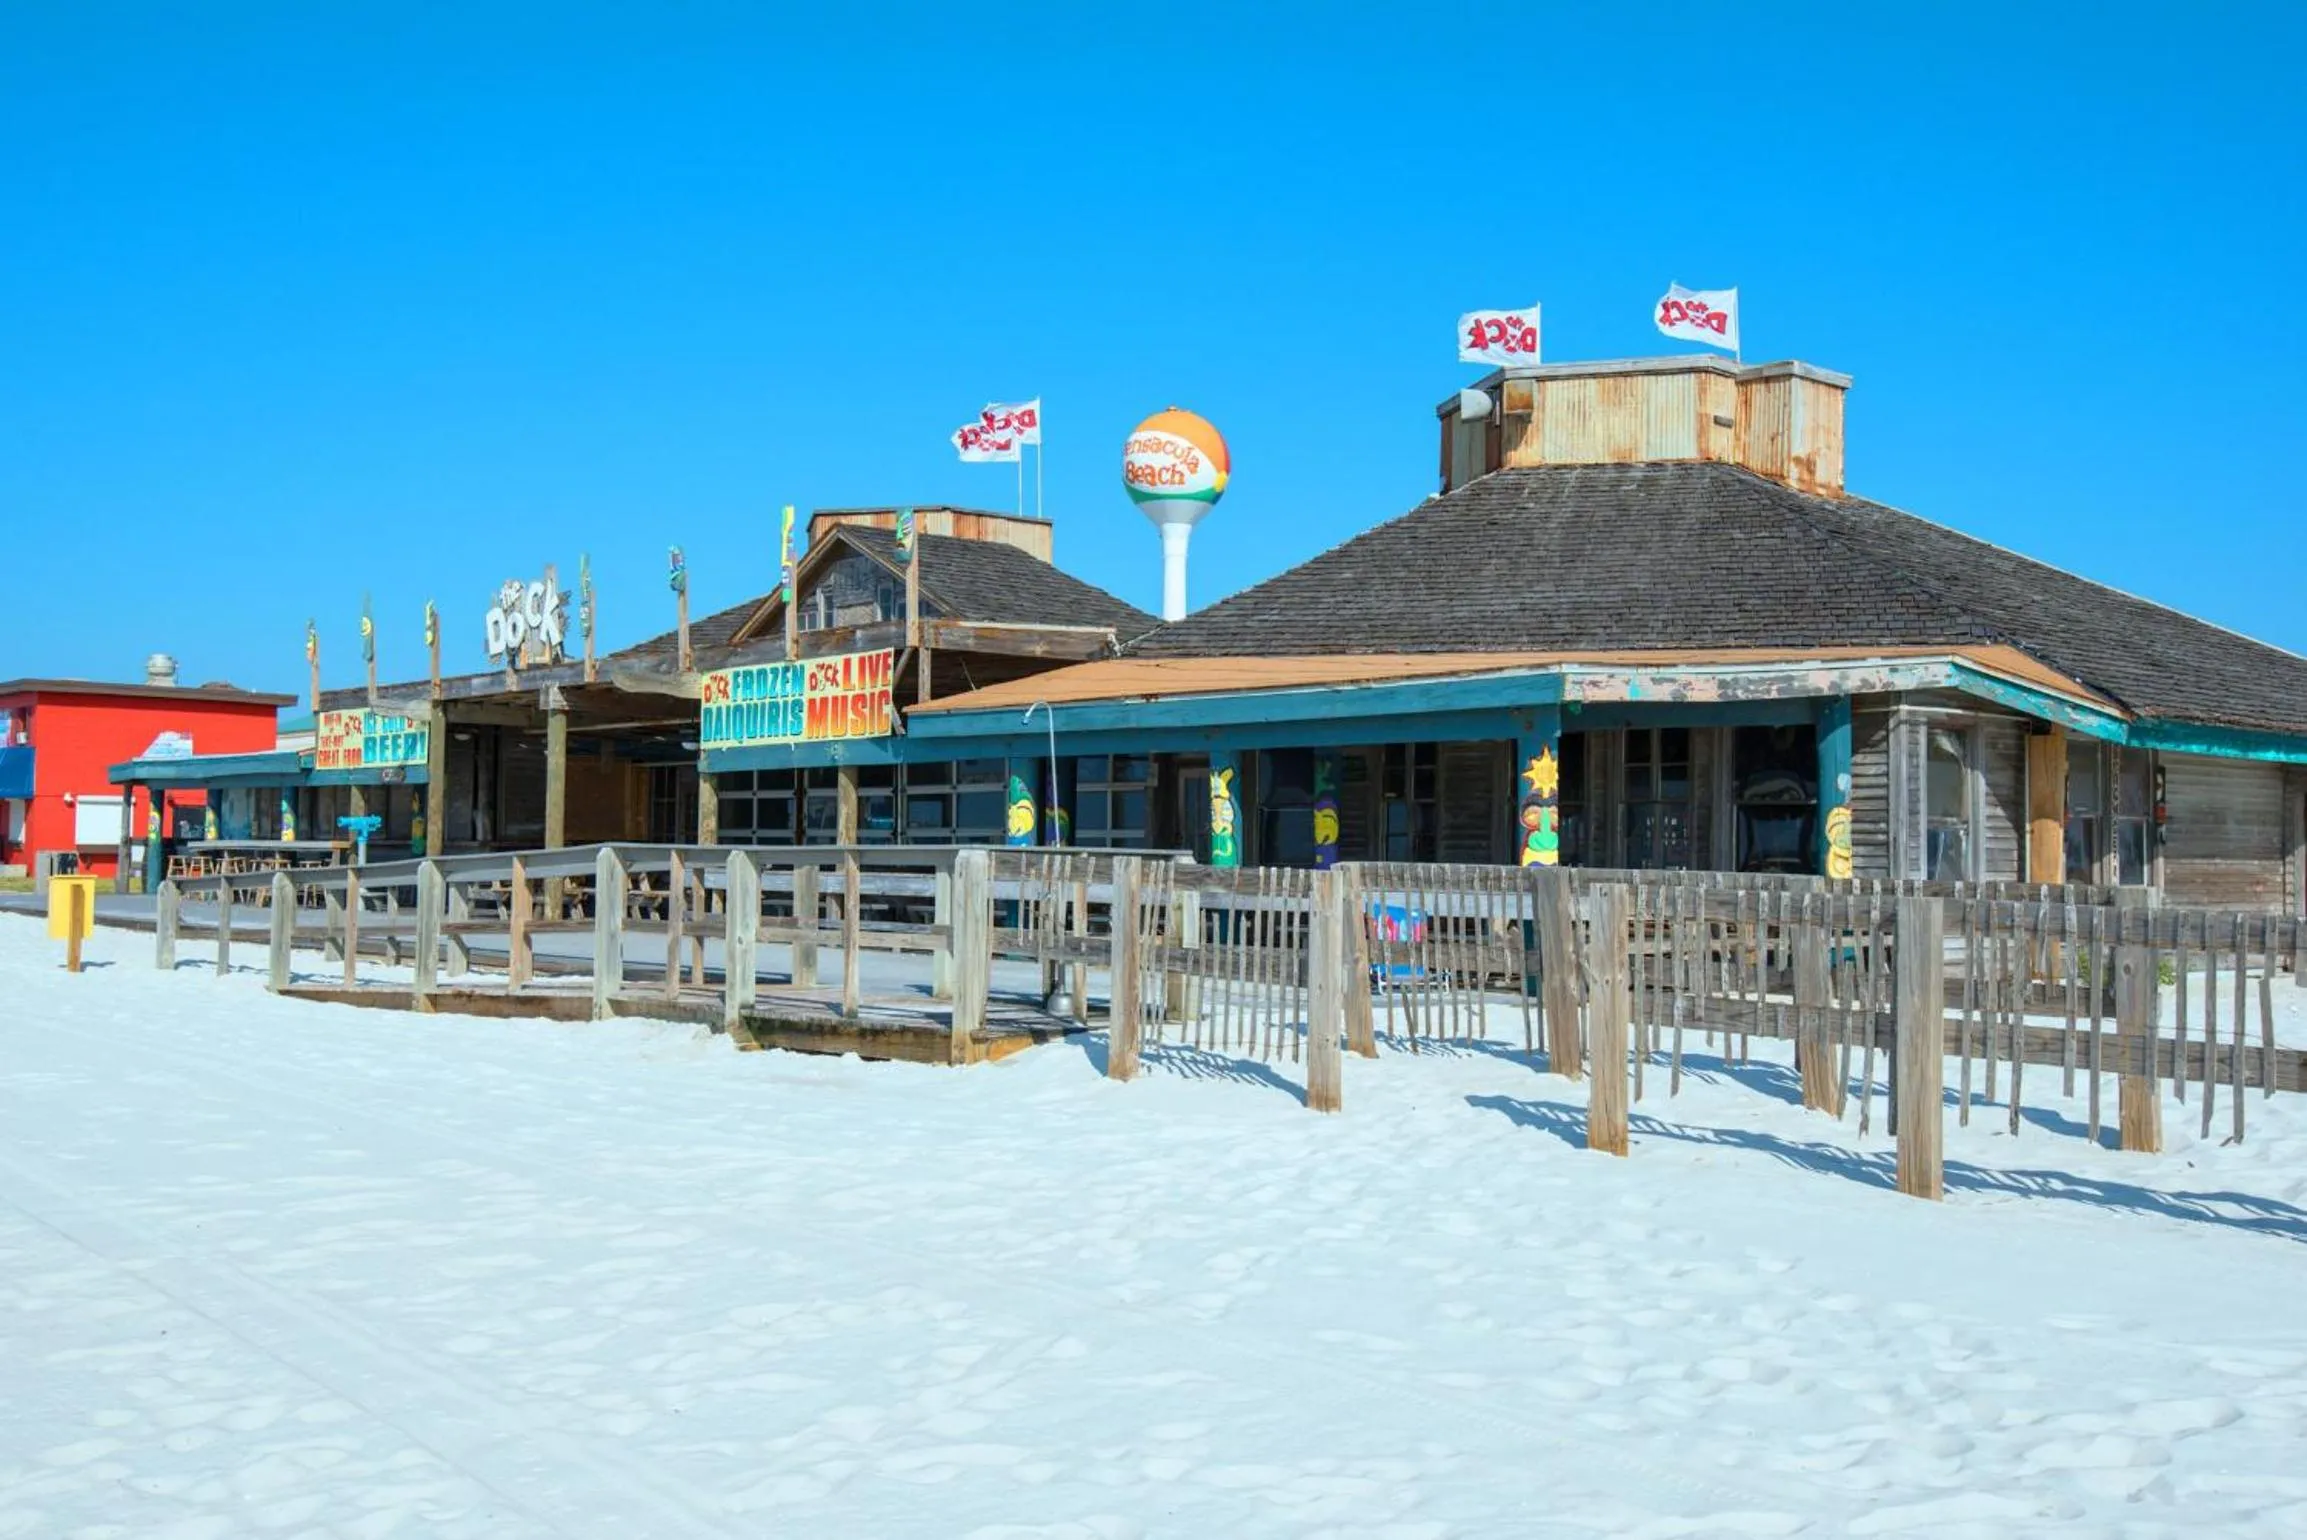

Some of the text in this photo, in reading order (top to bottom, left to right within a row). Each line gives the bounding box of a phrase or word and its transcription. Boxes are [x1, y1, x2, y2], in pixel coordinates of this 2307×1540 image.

[1126, 461, 1185, 486] Beach
[732, 664, 806, 702] FROZEN
[842, 652, 892, 691] LIVE
[703, 699, 804, 742] DAIQUIRIS
[806, 689, 891, 739] MUSIC
[363, 732, 426, 763] BEER!
